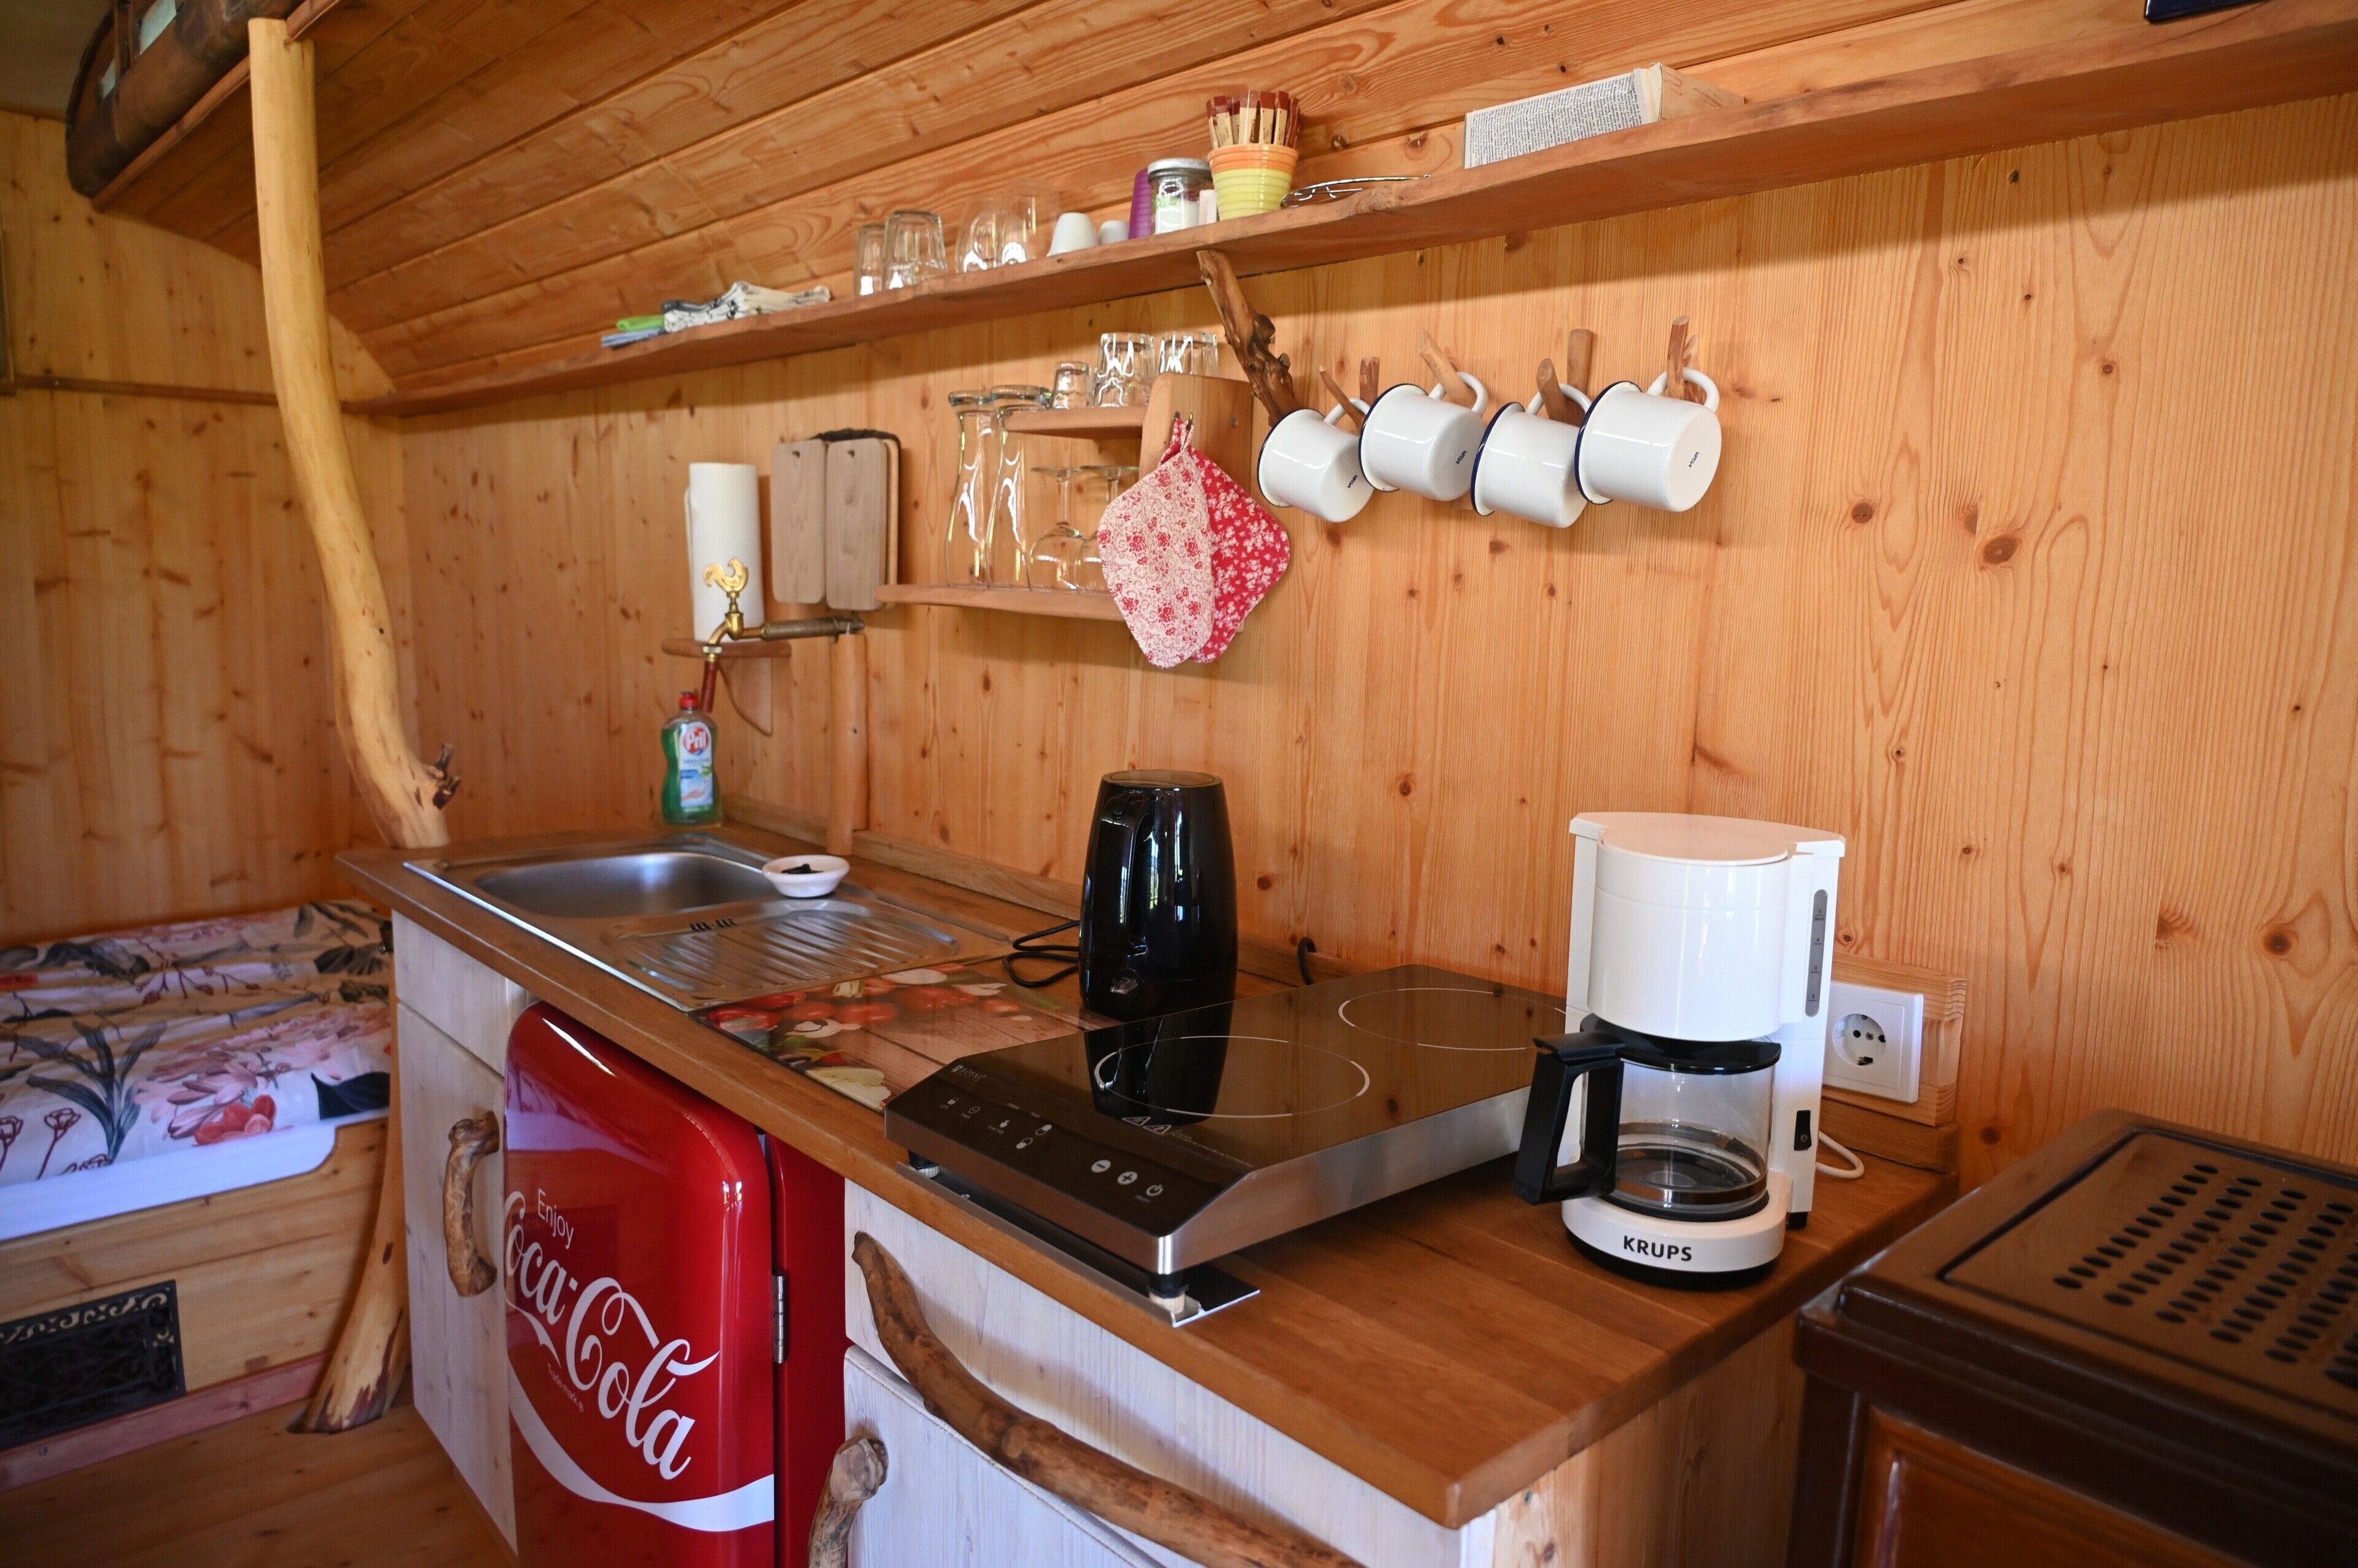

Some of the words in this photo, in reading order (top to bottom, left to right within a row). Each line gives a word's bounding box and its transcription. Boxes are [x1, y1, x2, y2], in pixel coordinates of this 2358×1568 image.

[687, 732, 706, 749] Pril
[538, 1189, 574, 1249] Enjoy
[1624, 1235, 1692, 1261] KRUPS
